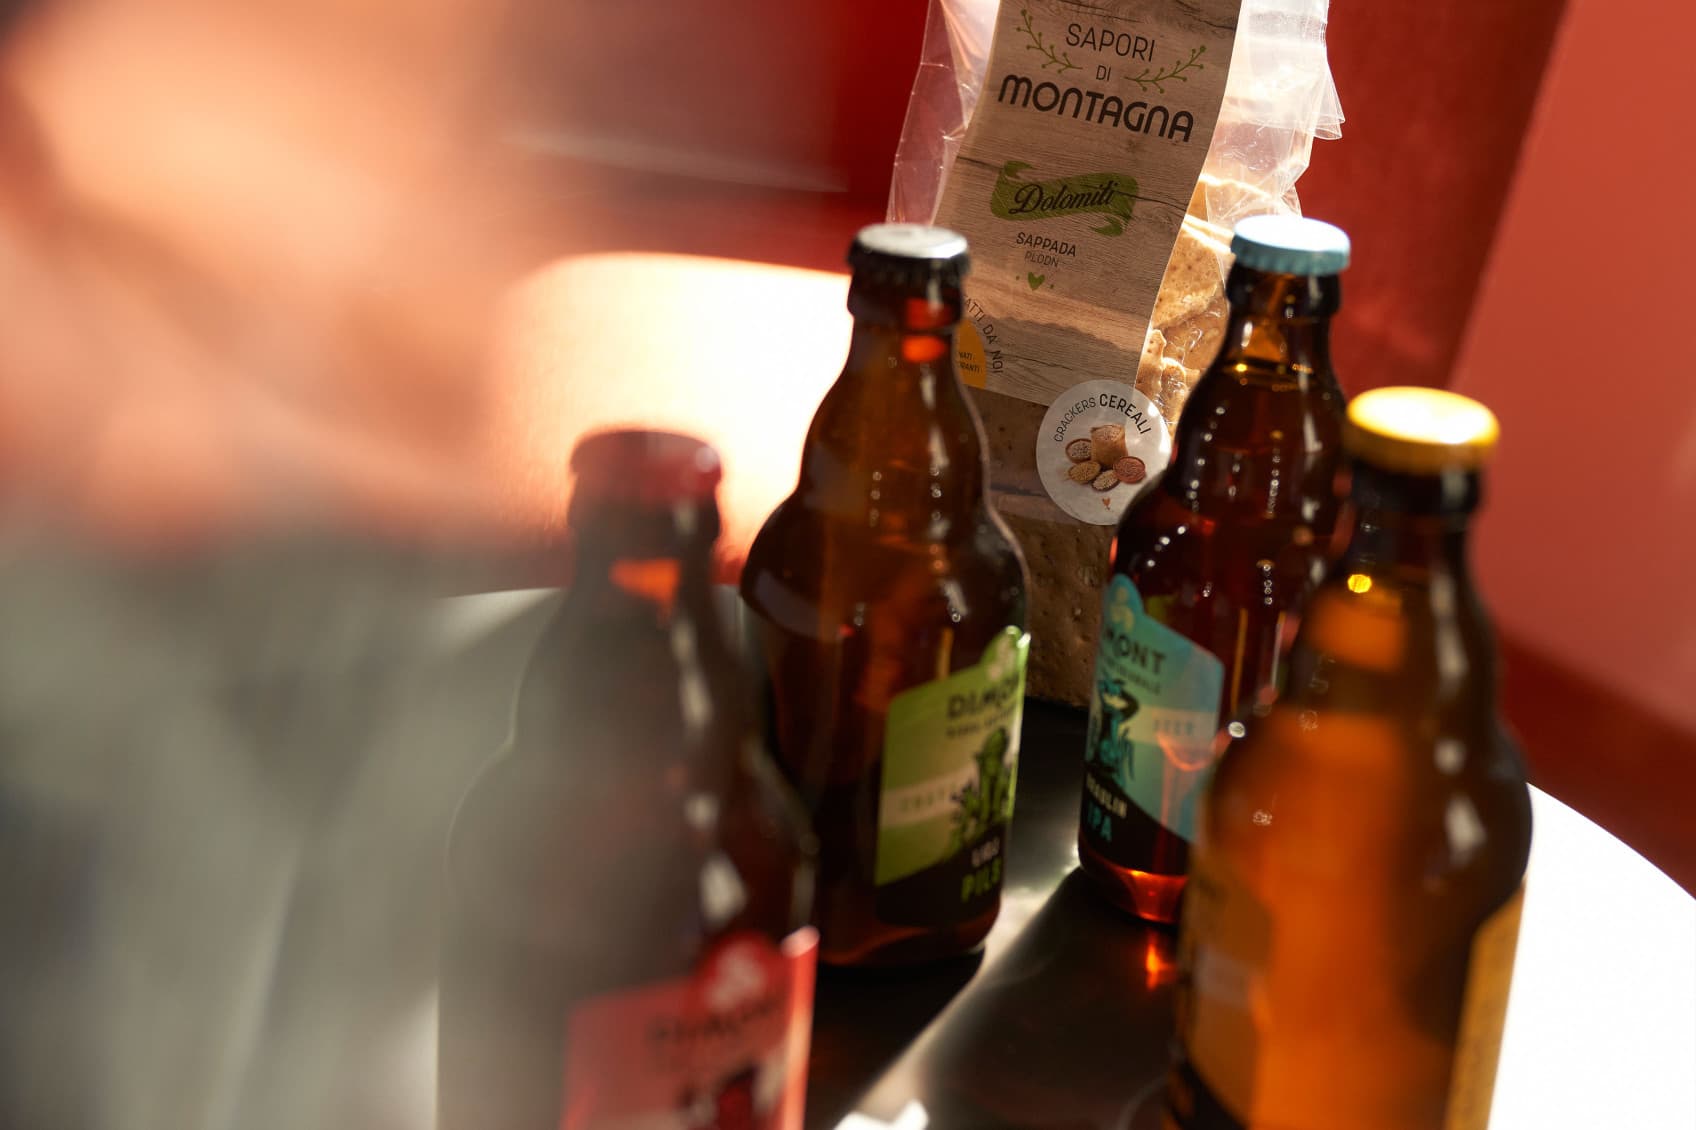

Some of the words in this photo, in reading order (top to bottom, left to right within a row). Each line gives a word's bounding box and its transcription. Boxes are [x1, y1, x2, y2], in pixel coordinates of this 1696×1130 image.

[1066, 23, 1155, 62] SAPORI
[1096, 65, 1111, 82] DI
[998, 74, 1194, 142] MONTAGNA
[1008, 180, 1118, 214] Dolomiti
[1016, 232, 1077, 257] SAPPADA
[1024, 250, 1060, 268] PLODN
[964, 298, 985, 321] ATTI
[990, 350, 1003, 373] NOI
[1054, 397, 1097, 442] CRACKERS
[1099, 393, 1152, 435] CEREALI
[1087, 801, 1113, 842] IPA
